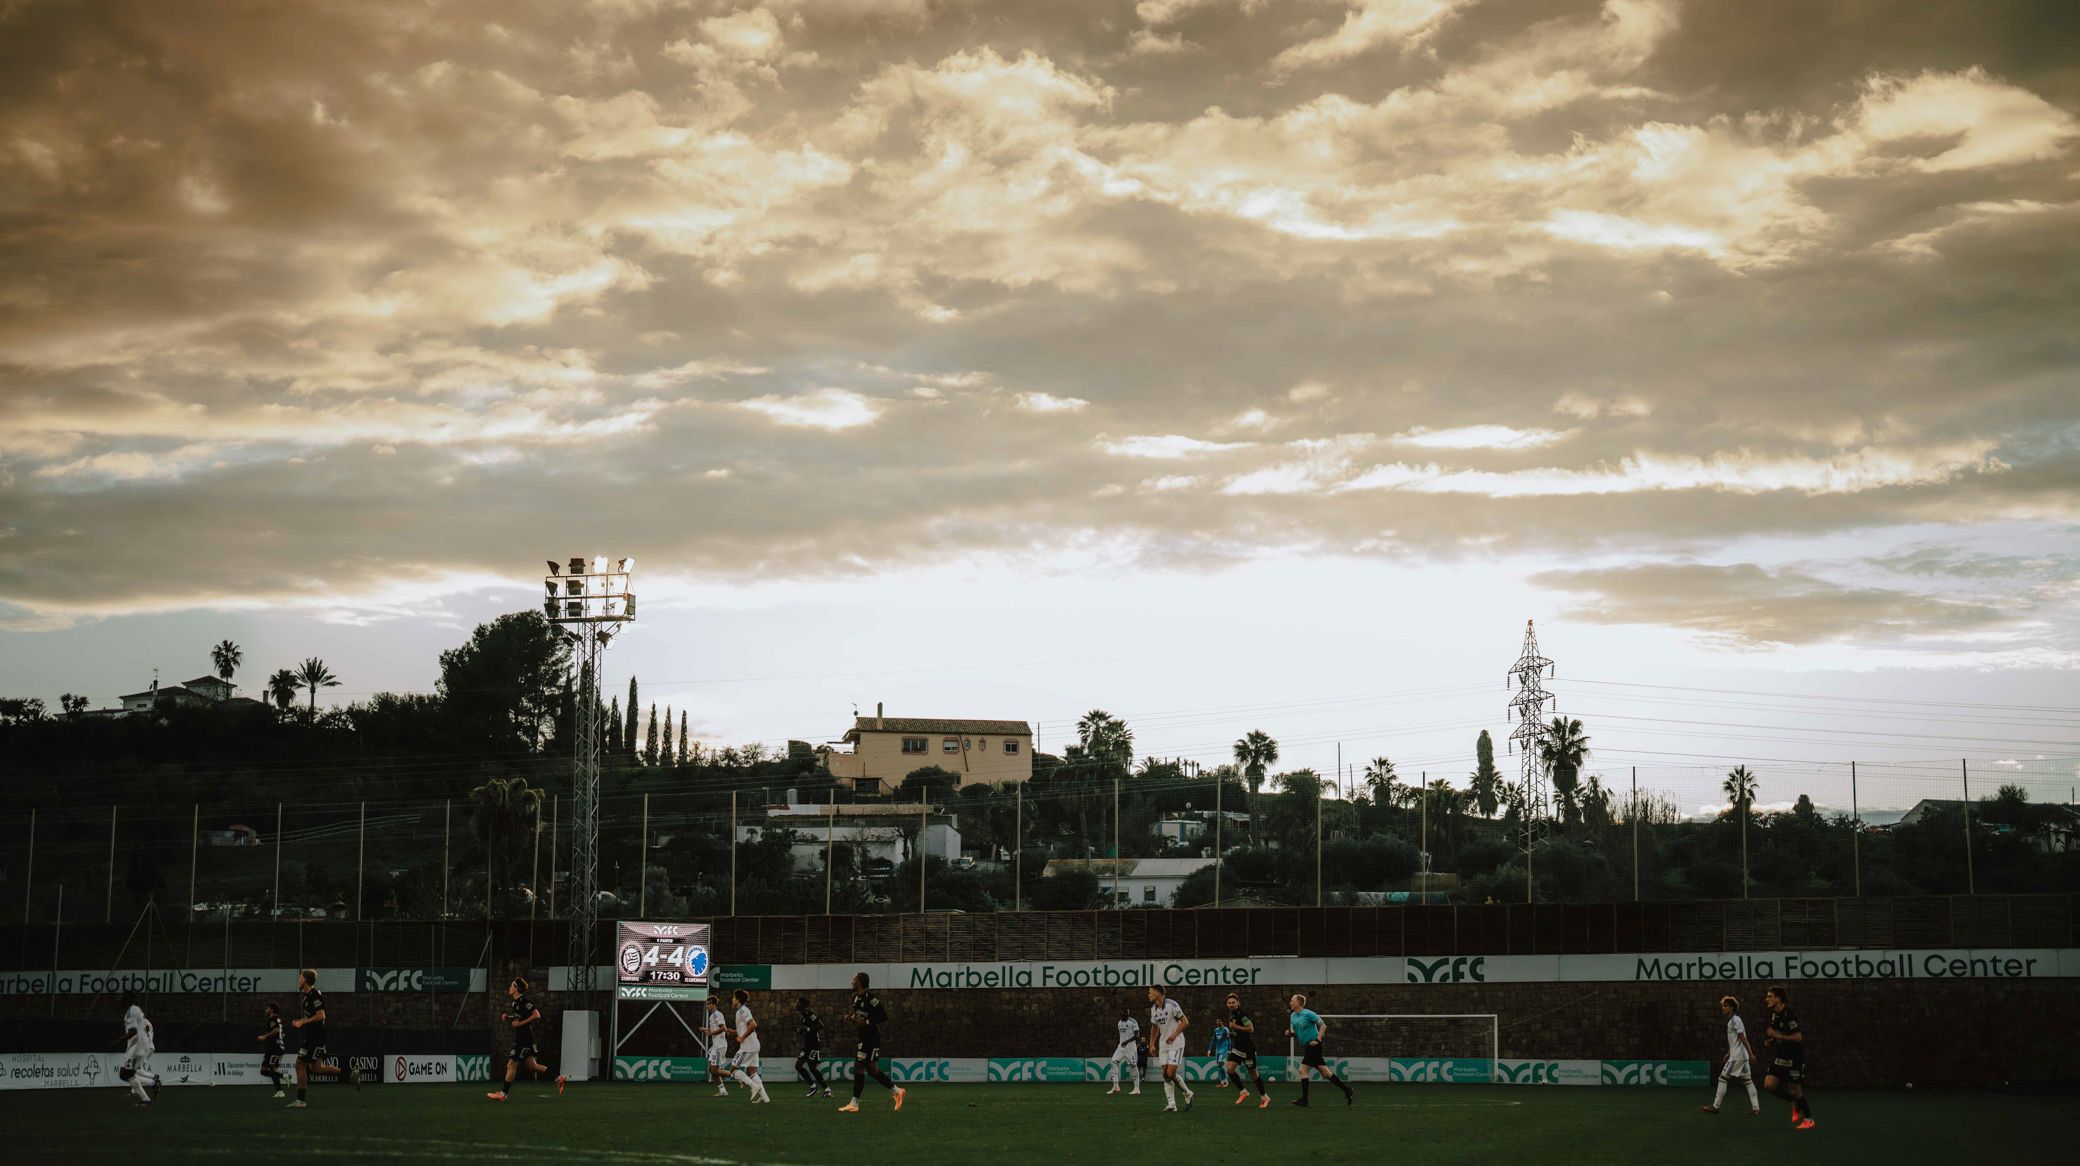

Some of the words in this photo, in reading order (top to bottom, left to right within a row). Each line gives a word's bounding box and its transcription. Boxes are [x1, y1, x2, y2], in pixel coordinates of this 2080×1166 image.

[1635, 956, 1773, 980] Marbella
[1785, 954, 1914, 979] Football
[1924, 953, 2037, 978] Center
[80, 972, 173, 993] Football
[181, 972, 261, 993] Center
[650, 971, 680, 980] 17:30
[910, 966, 1033, 988] Marbella
[1042, 964, 1154, 987] Football
[1163, 963, 1261, 986] Center
[167, 1064, 203, 1073] MARBELLA
[349, 1056, 379, 1070] CASINO
[408, 1062, 433, 1075] GAME
[435, 1062, 448, 1075] ON
[10, 1063, 54, 1079] recoletas
[56, 1063, 81, 1077] salud
